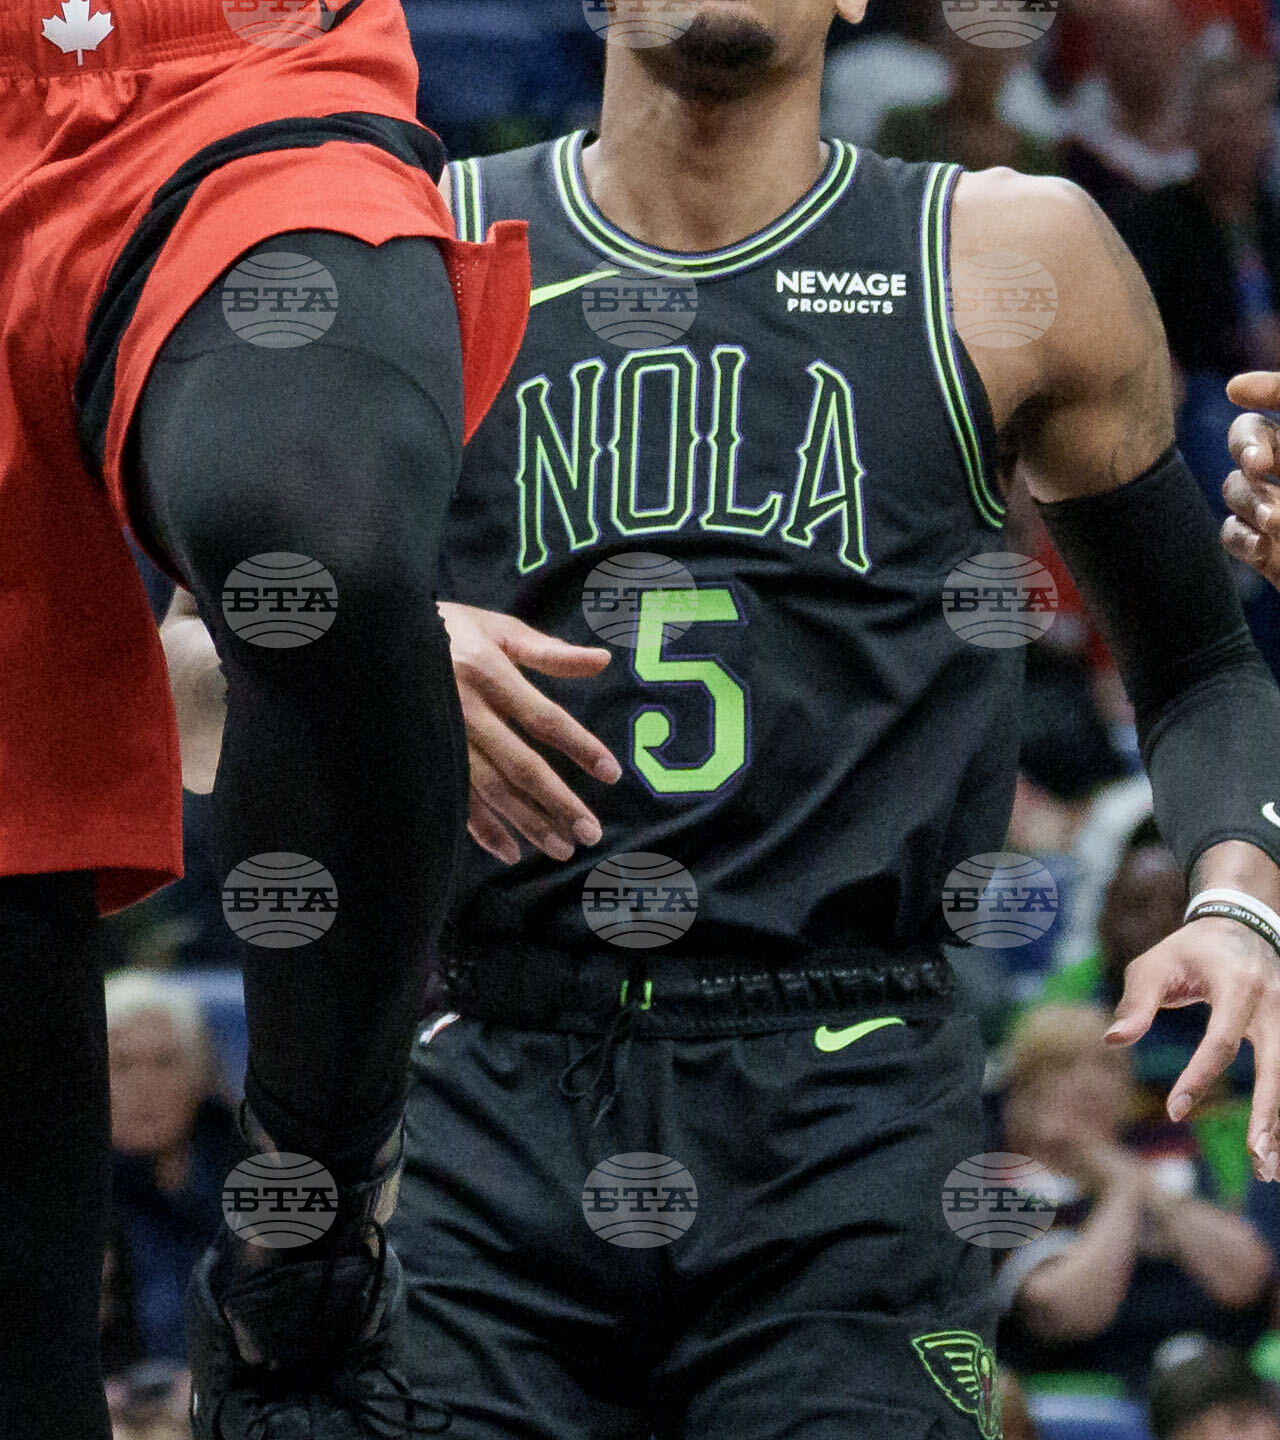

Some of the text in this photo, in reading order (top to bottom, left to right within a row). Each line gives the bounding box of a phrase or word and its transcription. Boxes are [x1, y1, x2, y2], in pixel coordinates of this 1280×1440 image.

[776, 270, 907, 296] NEWAGE
[787, 298, 894, 315] PRODUCTS
[516, 345, 870, 574] NOLA
[630, 584, 751, 796] 5
